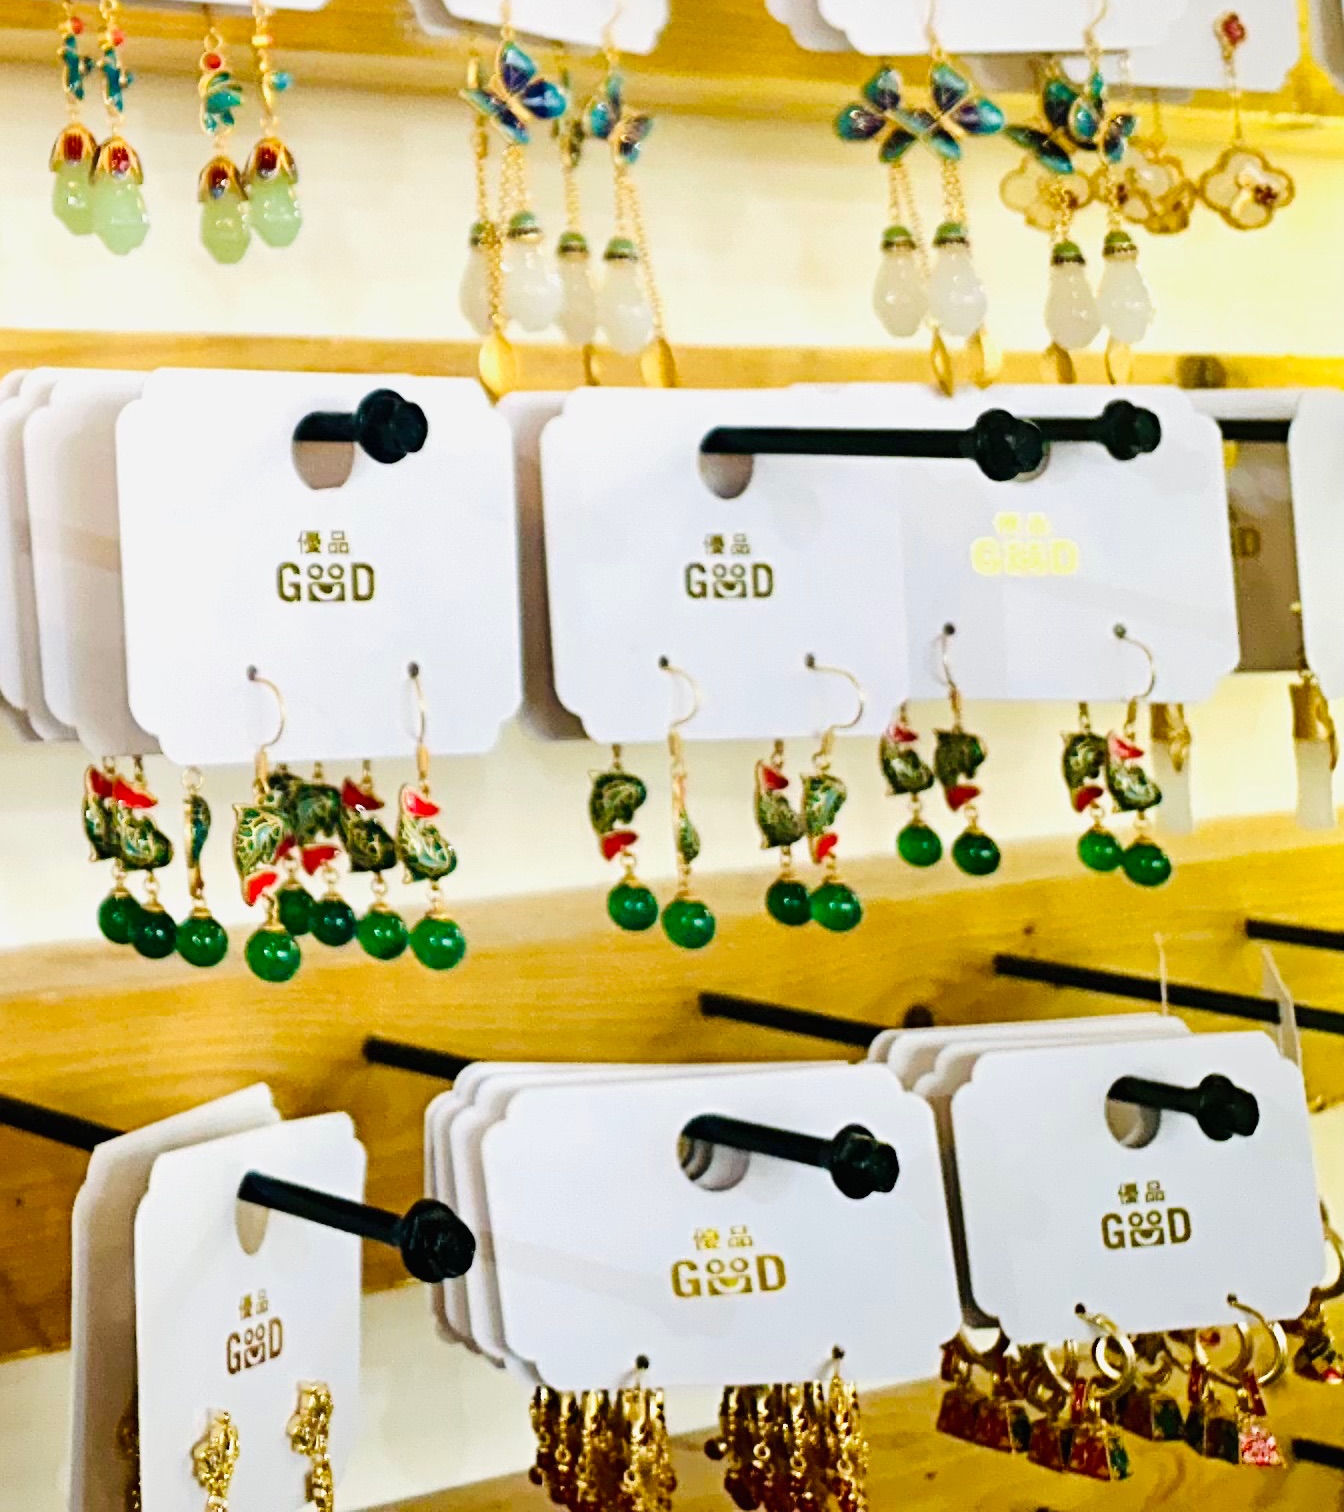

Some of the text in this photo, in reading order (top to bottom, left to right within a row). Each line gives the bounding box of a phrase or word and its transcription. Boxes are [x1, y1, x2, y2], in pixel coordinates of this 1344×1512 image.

[297, 530, 349, 553] 優品
[276, 562, 375, 603] GOOD
[685, 562, 774, 598] GOOD
[1118, 1180, 1165, 1205] 優品
[693, 1225, 753, 1250] 優品
[1101, 1207, 1192, 1249] GOOD
[671, 1254, 786, 1297] GOOD
[226, 1319, 283, 1375] GOOD
